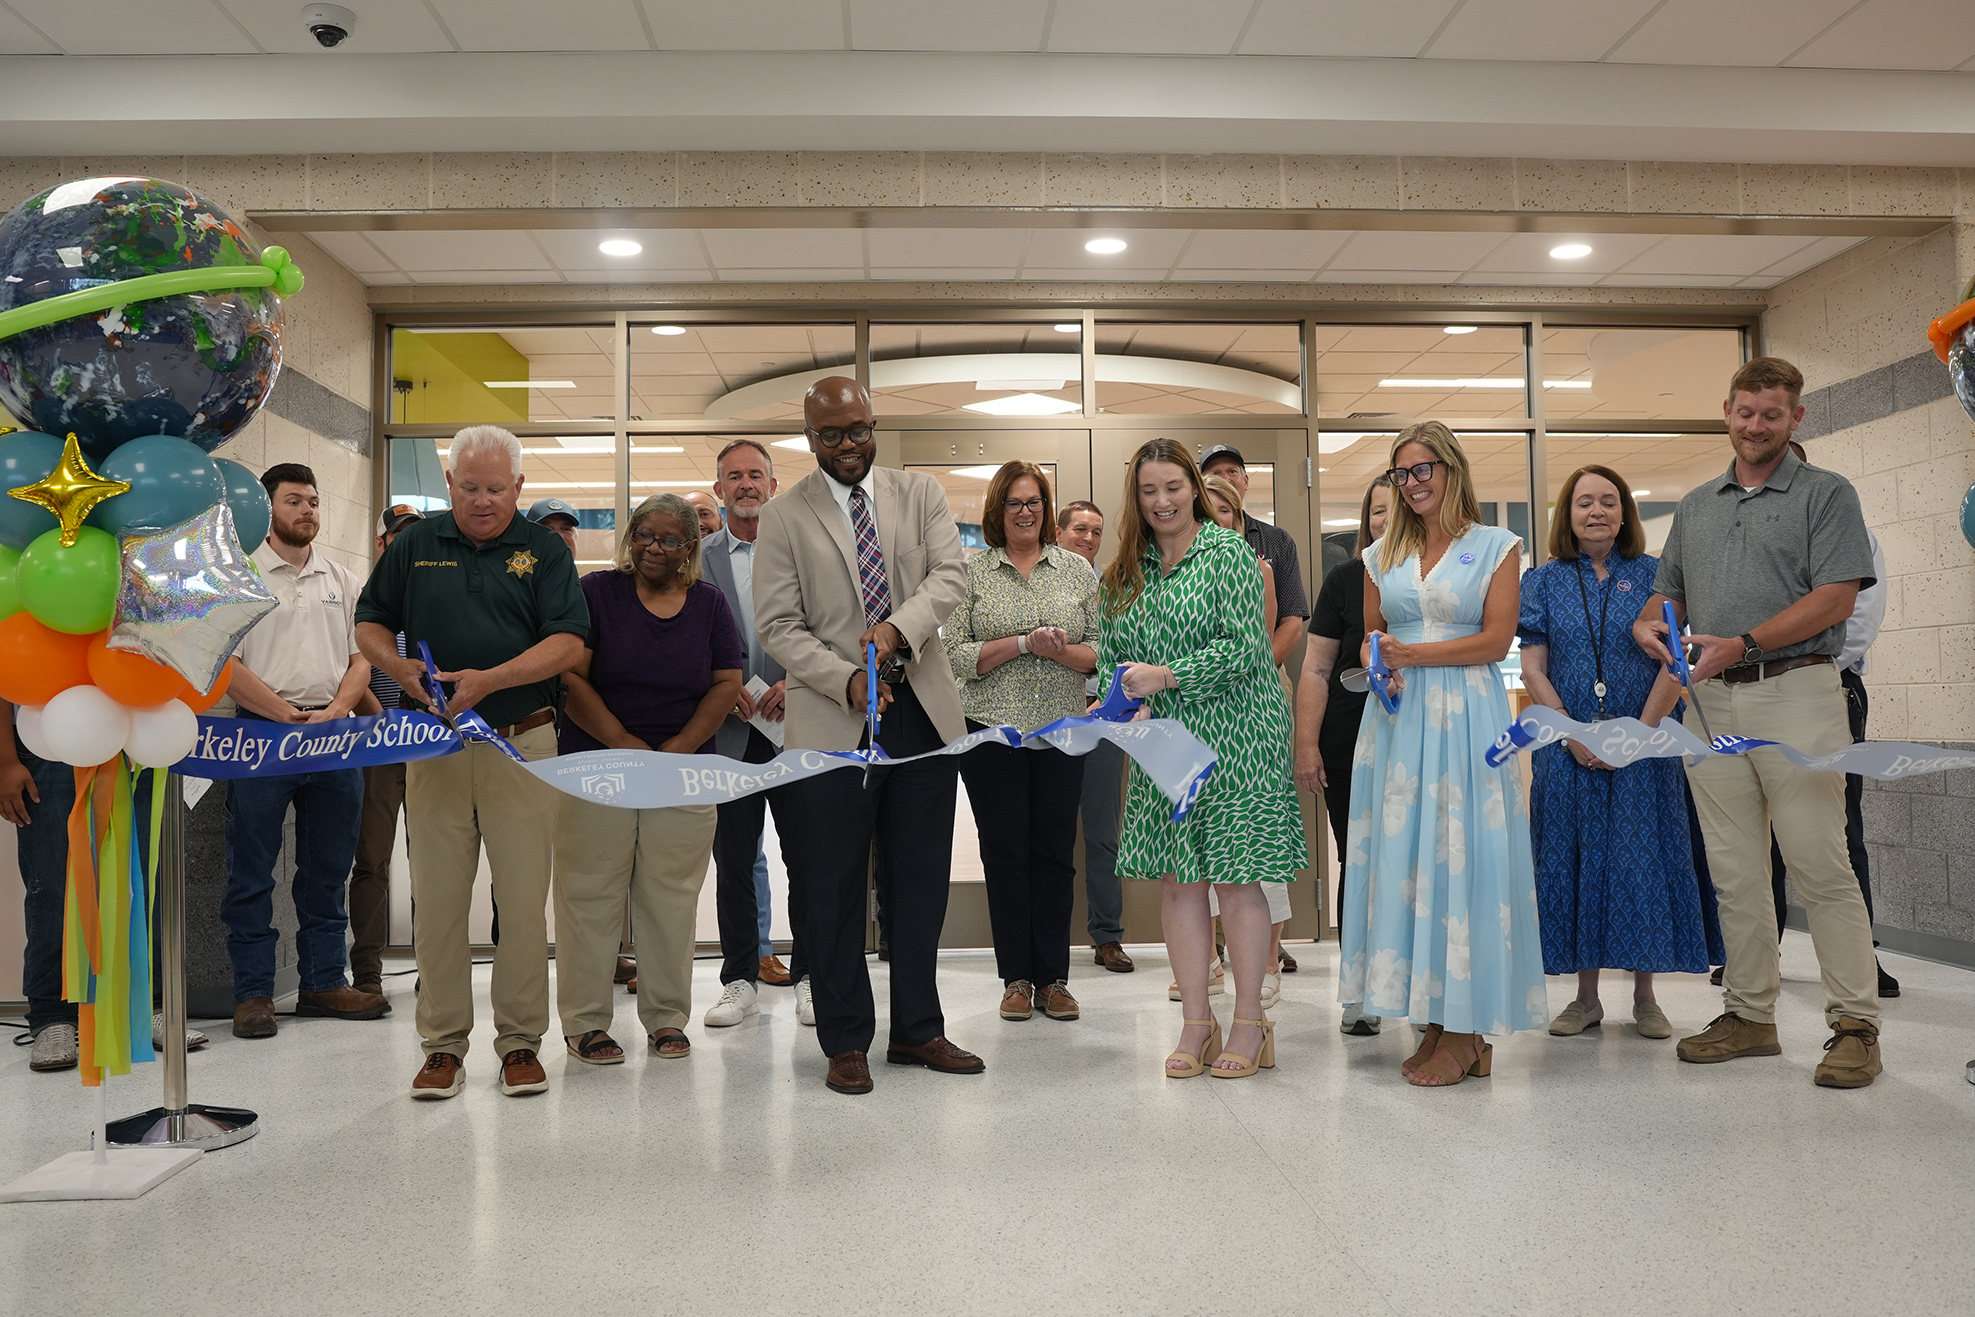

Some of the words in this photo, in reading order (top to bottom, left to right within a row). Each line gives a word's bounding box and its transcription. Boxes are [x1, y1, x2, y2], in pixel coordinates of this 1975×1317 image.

[414, 560, 438, 568] SHERIFF
[187, 725, 272, 770] rkeley
[278, 729, 365, 761] County
